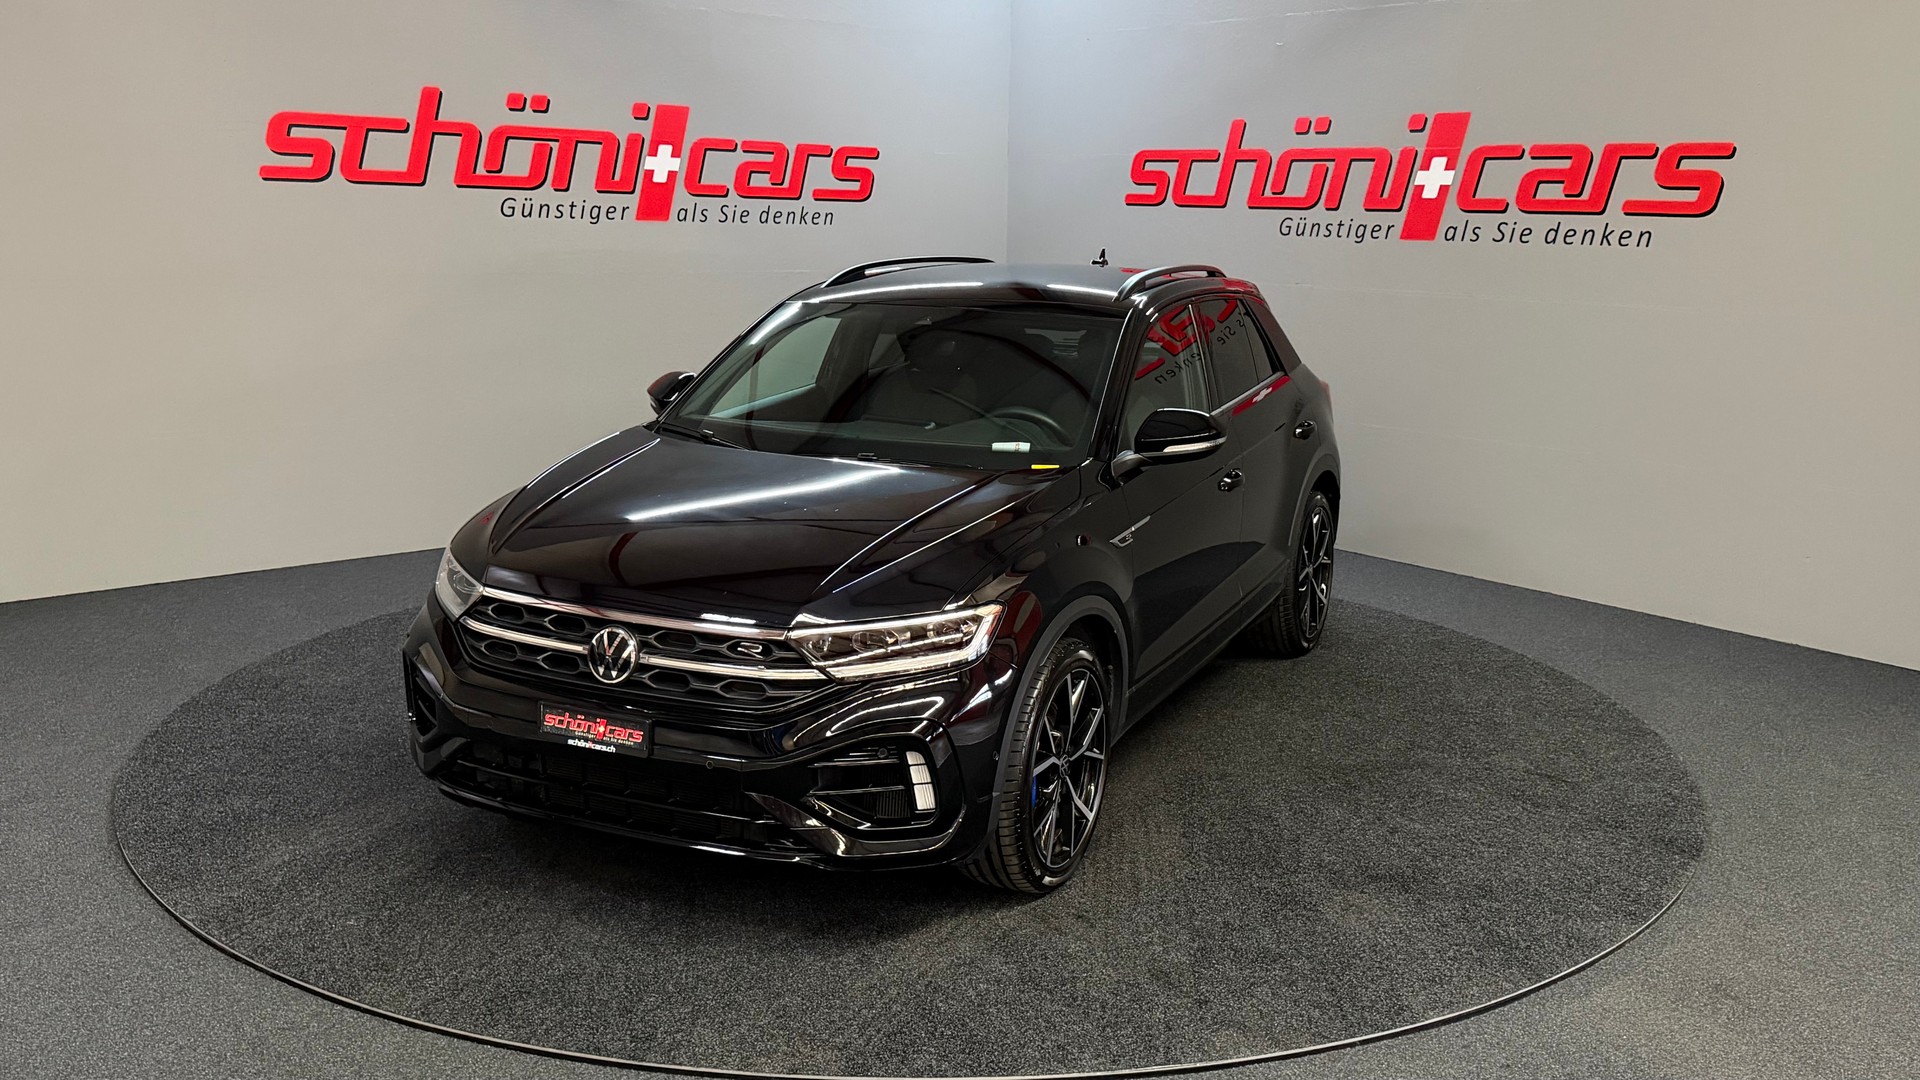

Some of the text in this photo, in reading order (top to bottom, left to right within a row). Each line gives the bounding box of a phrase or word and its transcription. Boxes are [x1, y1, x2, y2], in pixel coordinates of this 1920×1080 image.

[499, 196, 835, 227] Günstiger als Sie denken
[1278, 216, 1654, 249] Günstiger als Sie denken
